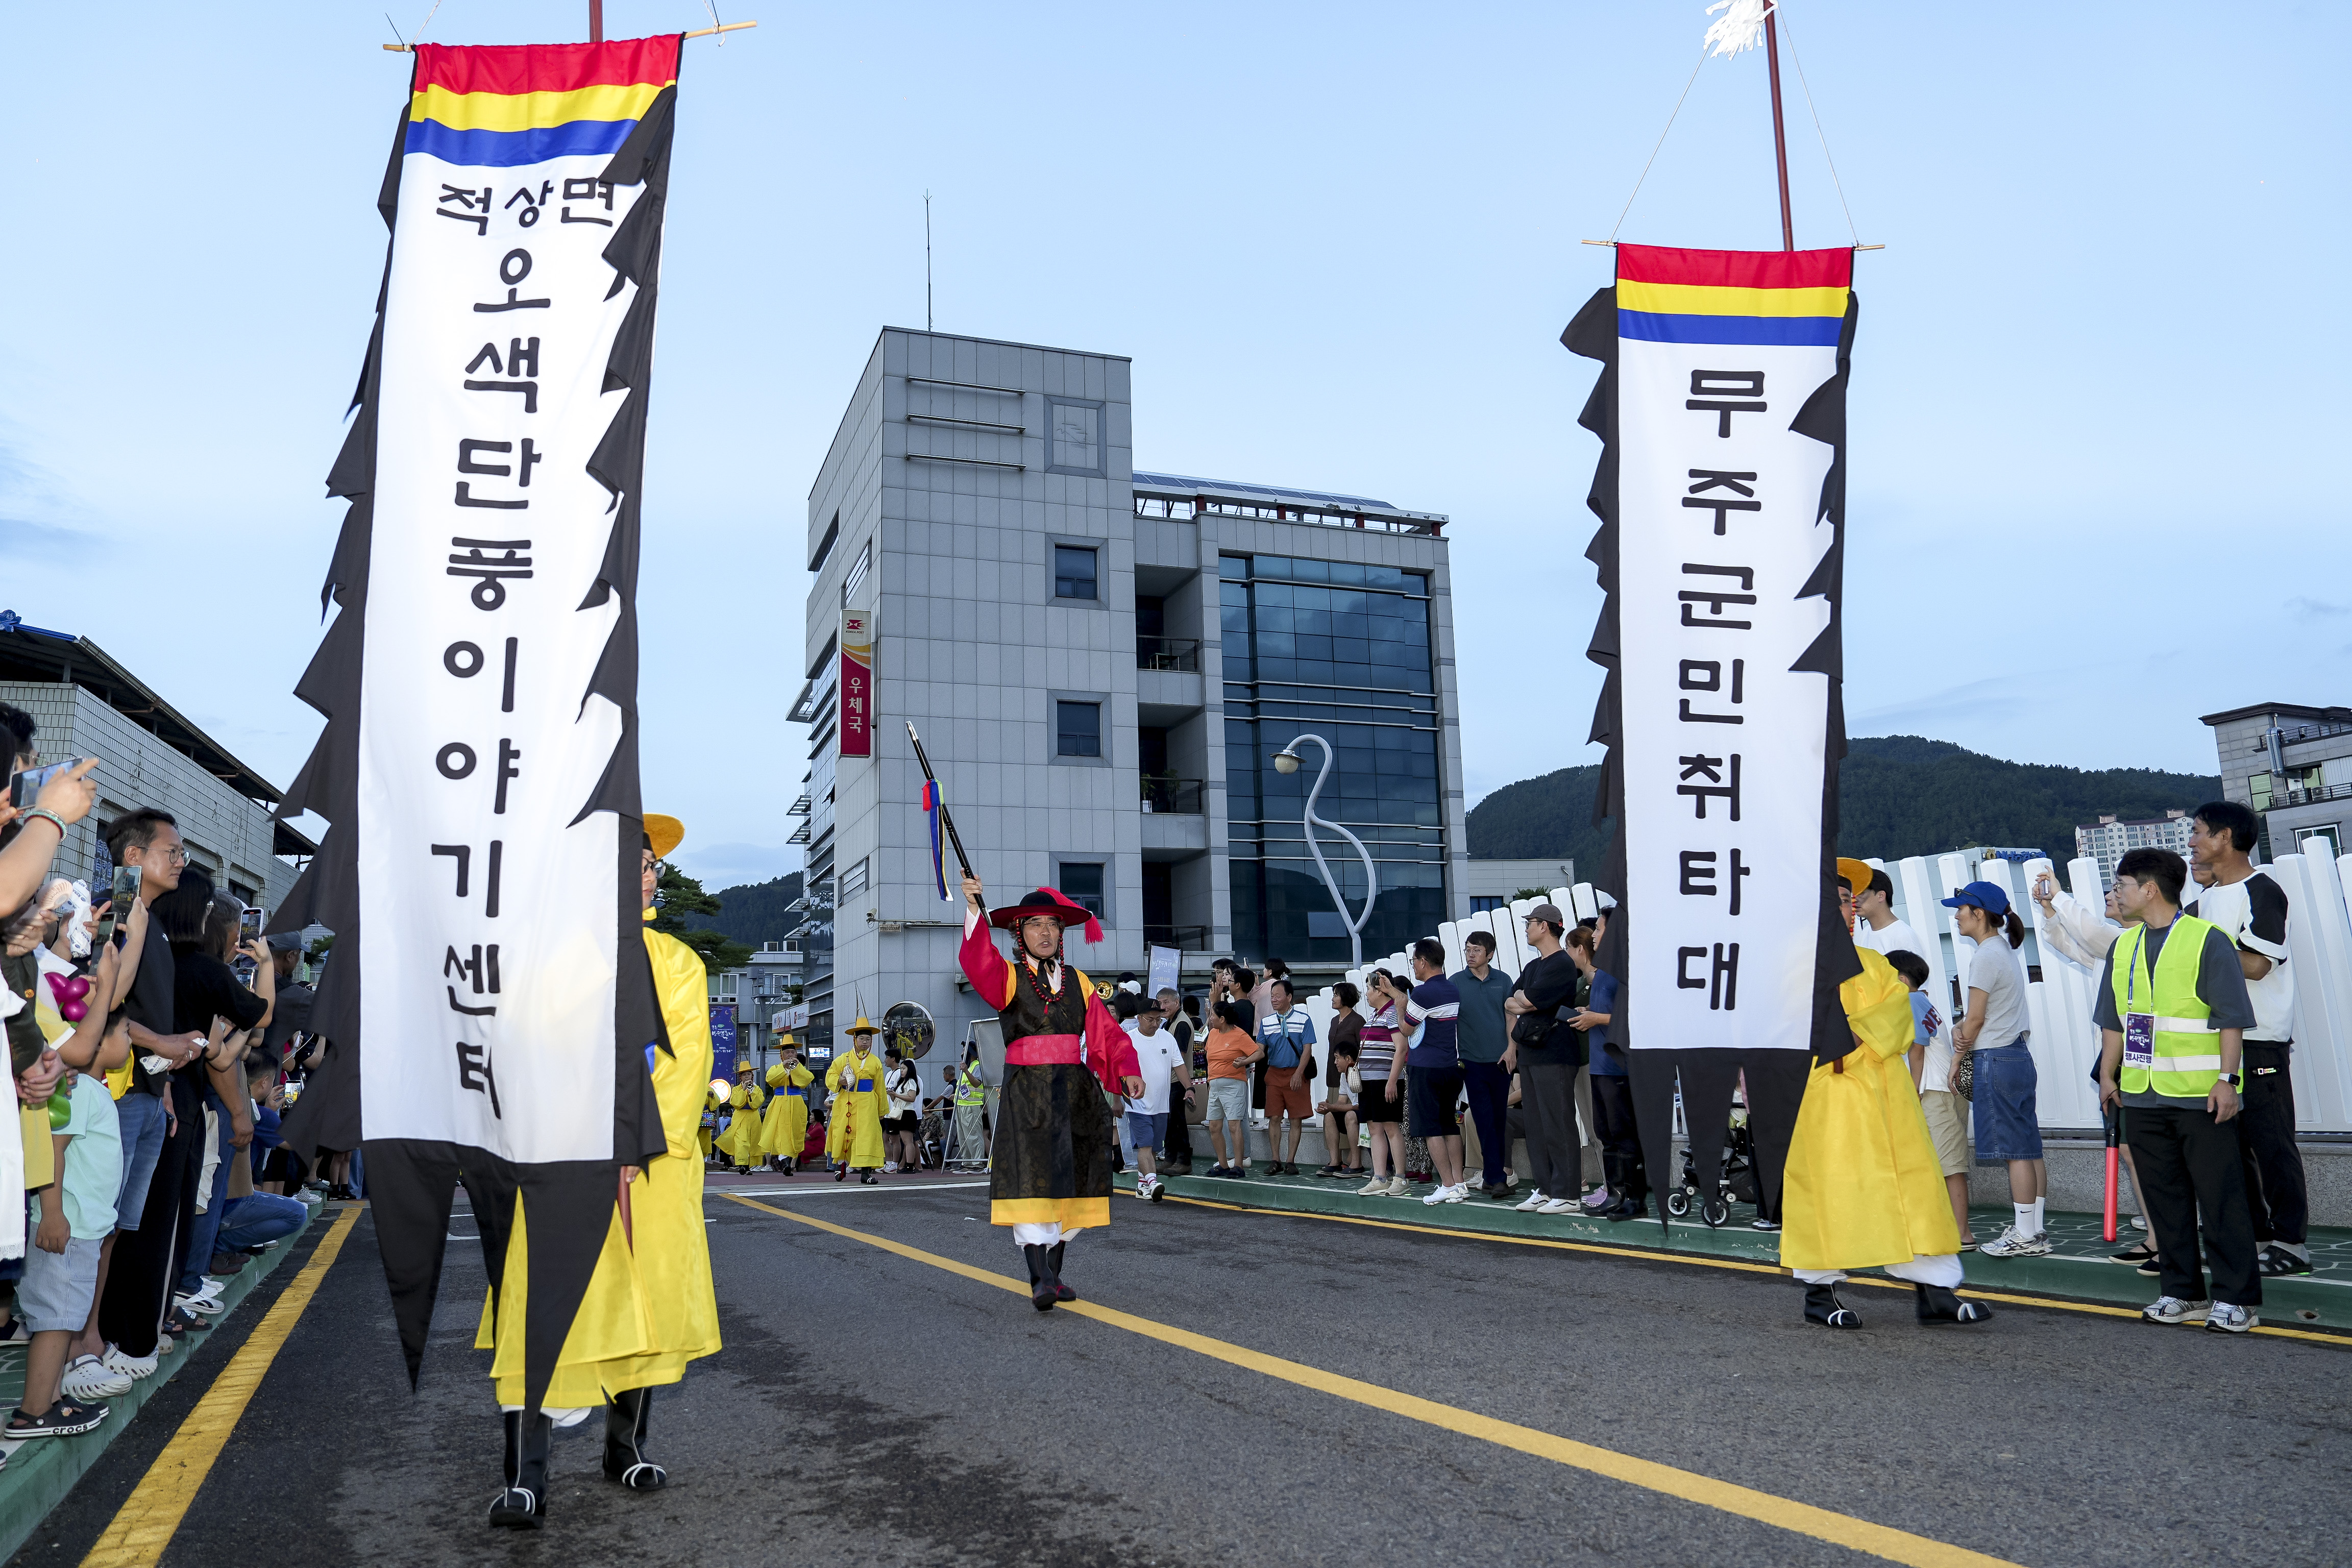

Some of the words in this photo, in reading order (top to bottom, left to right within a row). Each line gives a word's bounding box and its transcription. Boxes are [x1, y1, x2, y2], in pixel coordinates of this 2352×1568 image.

[436, 177, 614, 236] 적상면
[431, 248, 551, 1119] 오색단풍이야기센터
[848, 677, 863, 733] 우체국
[1677, 370, 1767, 1011] 무주군민취타대
[1922, 1005, 1943, 1034] NE
[2125, 1052, 2152, 1064] 행사진행
[53, 1424, 88, 1434] crocs
